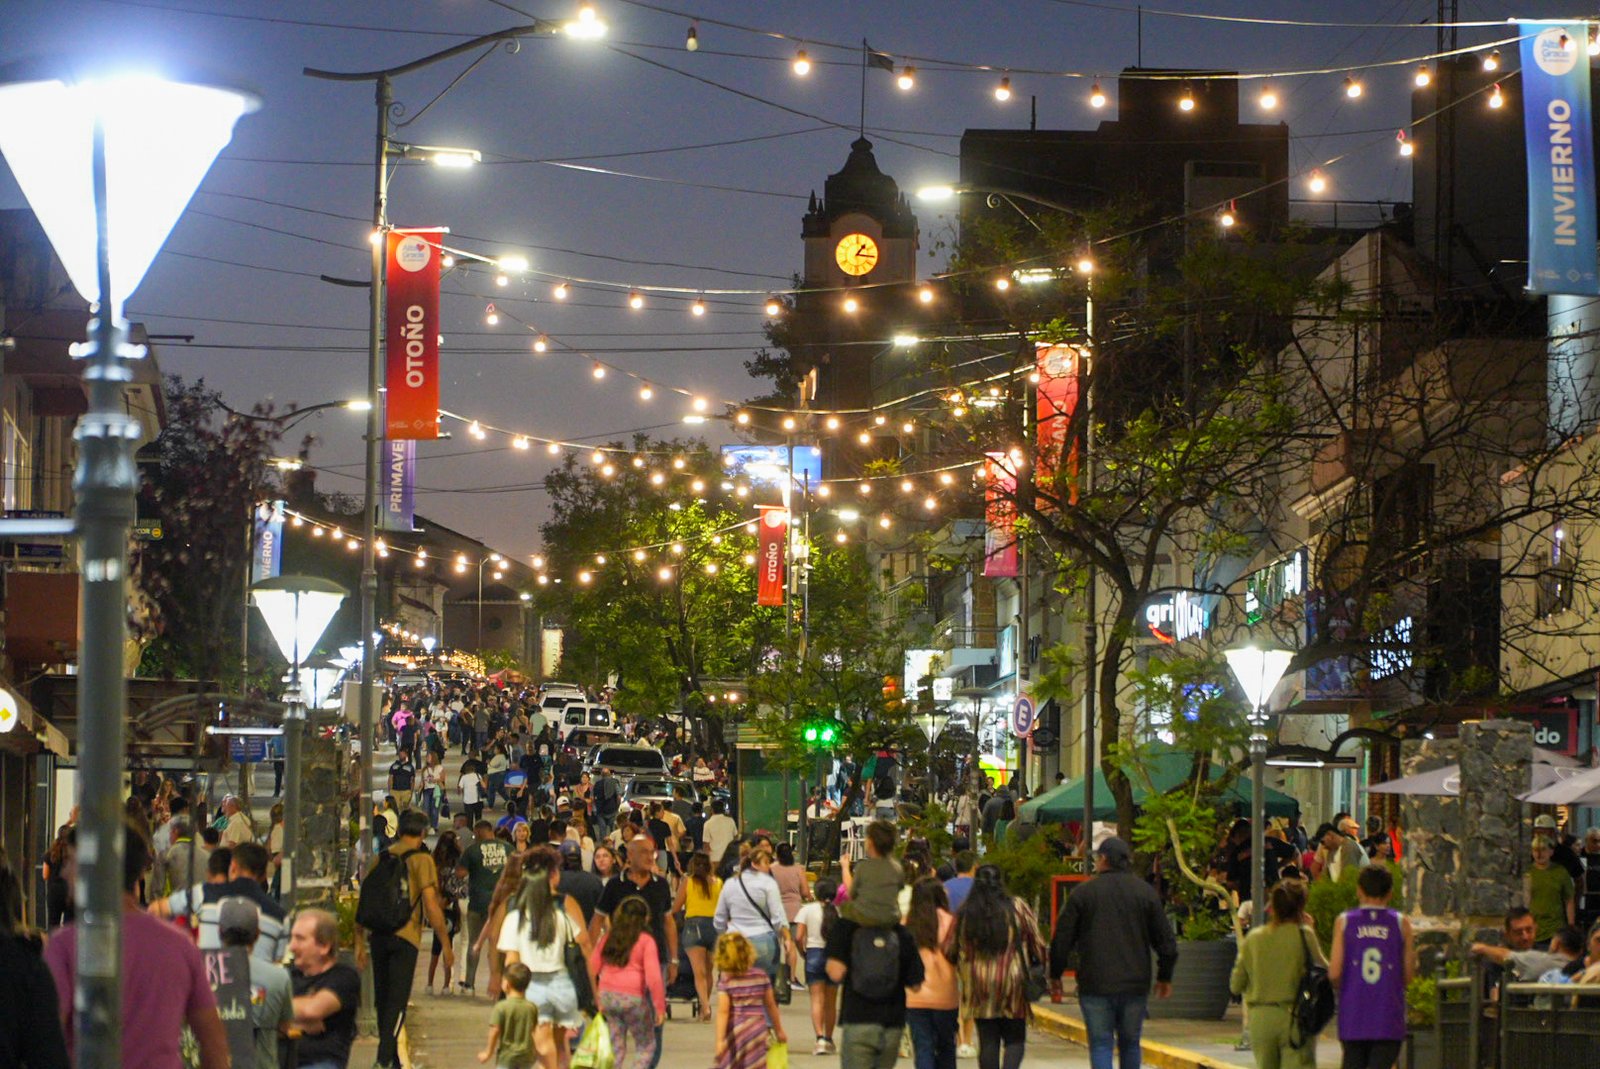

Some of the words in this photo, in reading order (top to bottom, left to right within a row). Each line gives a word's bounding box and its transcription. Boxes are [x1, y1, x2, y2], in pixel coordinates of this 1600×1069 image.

[1547, 99, 1577, 246] INVIERNO
[400, 305, 425, 388] OTOÑO
[390, 439, 404, 513] PRIMAVE
[766, 542, 778, 583] OTOÑO
[1017, 704, 1029, 727] E
[1356, 925, 1389, 940] JAMES
[1362, 947, 1382, 985] 6
